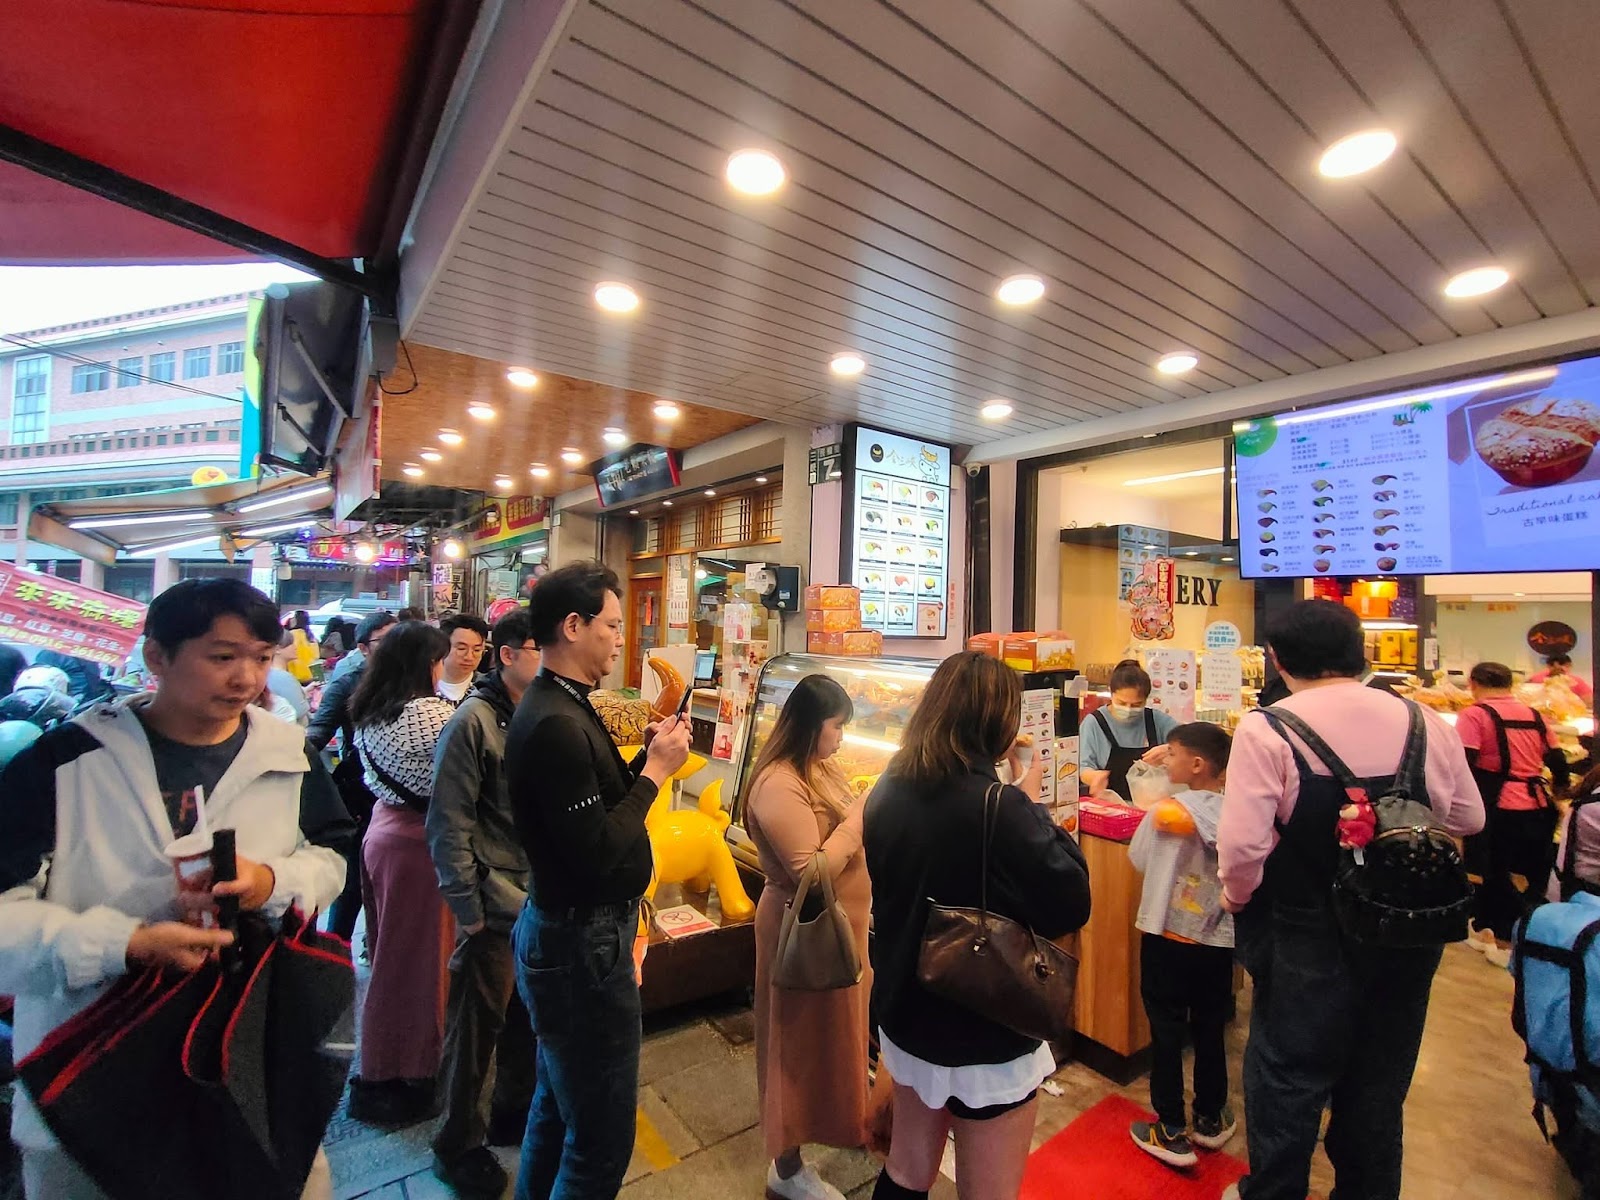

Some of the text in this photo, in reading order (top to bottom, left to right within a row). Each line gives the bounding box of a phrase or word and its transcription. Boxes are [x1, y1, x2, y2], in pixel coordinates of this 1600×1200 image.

[1487, 494, 1573, 516] Traditional
[1523, 511, 1588, 528] 古早味蛋糕
